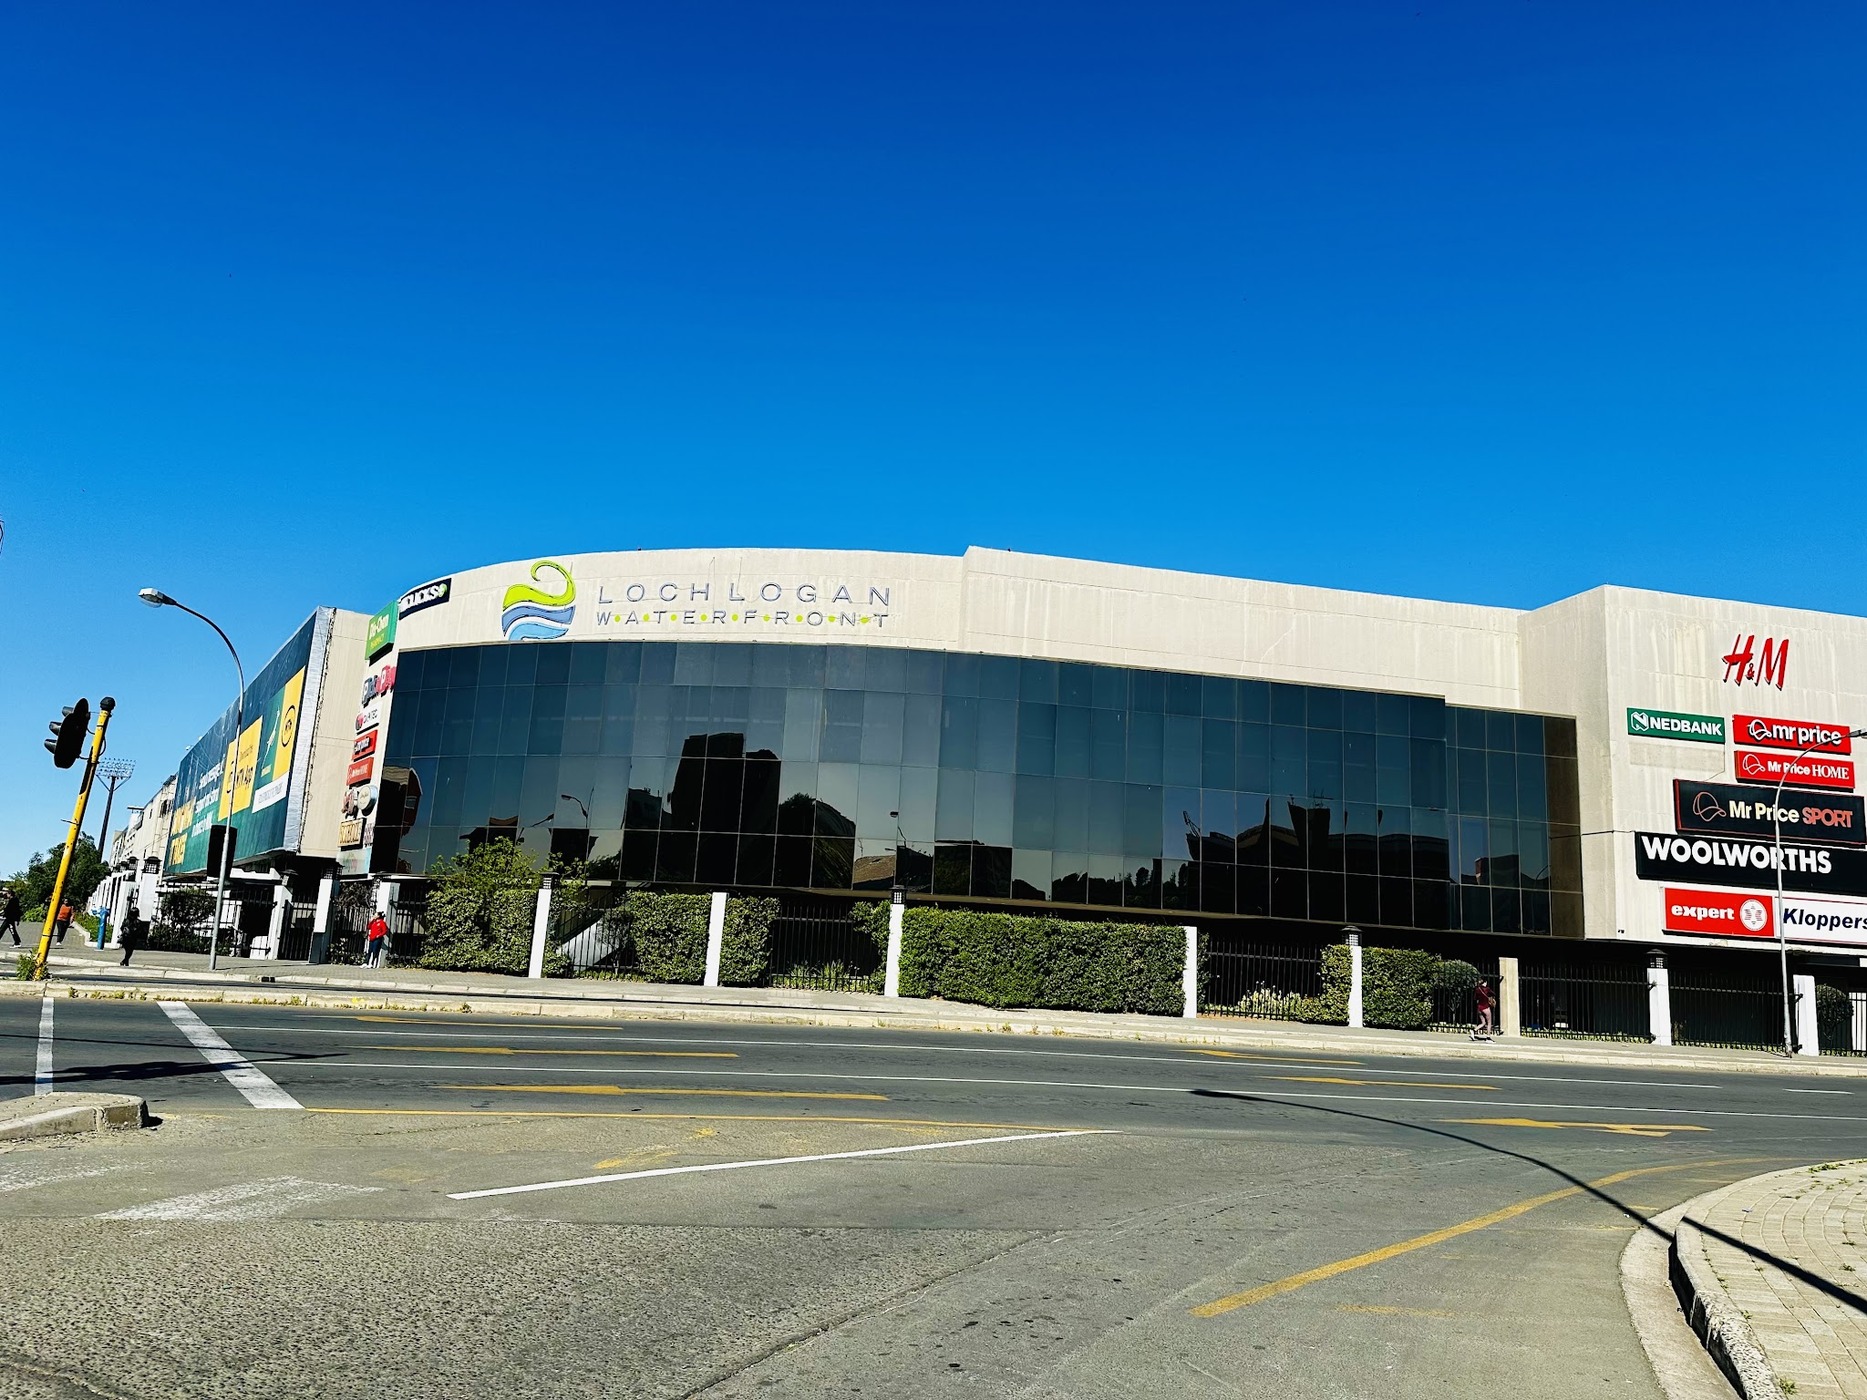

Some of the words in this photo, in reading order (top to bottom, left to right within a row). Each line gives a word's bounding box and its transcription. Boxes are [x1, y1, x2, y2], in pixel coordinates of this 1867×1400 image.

[598, 582, 710, 604] LOCH
[730, 582, 890, 606] LOGAN
[1722, 634, 1790, 691] H&M
[1650, 716, 1723, 736] NEDBANK
[1772, 724, 1797, 741] mr
[1797, 726, 1842, 745] price
[1767, 760, 1782, 772] Mr
[1783, 761, 1811, 776] Price
[1811, 764, 1850, 780] HOME
[1729, 800, 1752, 819] Mr
[1754, 803, 1800, 823] Price
[1801, 806, 1853, 828] SPORT
[1641, 835, 1833, 874] WOOLWORTHS
[1671, 904, 1735, 921] expert
